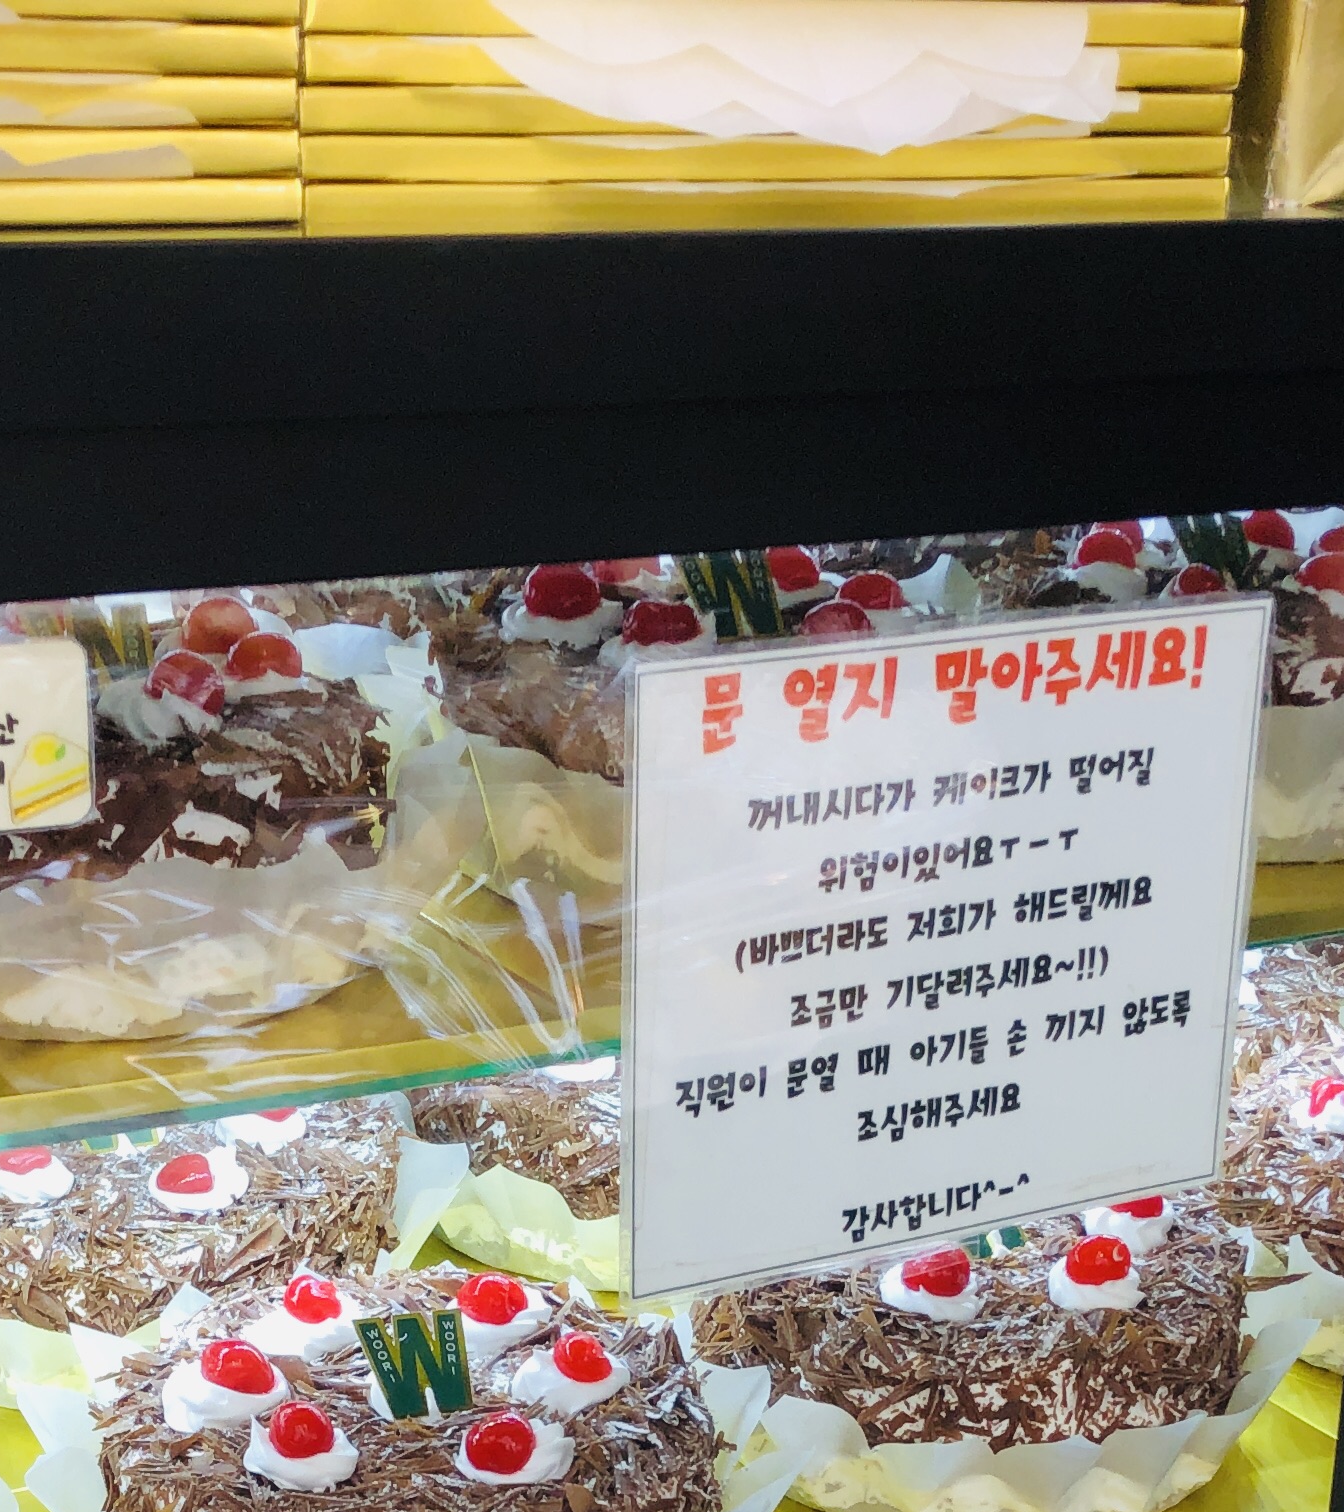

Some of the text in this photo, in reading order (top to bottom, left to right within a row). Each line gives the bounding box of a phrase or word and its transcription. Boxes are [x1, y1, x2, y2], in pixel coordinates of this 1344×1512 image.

[702, 625, 1209, 754] 문 열지 말아주세요!
[748, 747, 1155, 831] 꺼내시다가 케이크가 떨어질
[735, 875, 1153, 974] (바쁘더라도 저희가 해드릴께요
[790, 984, 868, 1029] 조금만
[676, 989, 1192, 1118] 직원이 문열 때 아기들 손 끼지 않도록
[857, 1082, 1021, 1142] 조심해주세요
[366, 1328, 396, 1383] WOORI
[441, 1320, 457, 1375] WOORI
